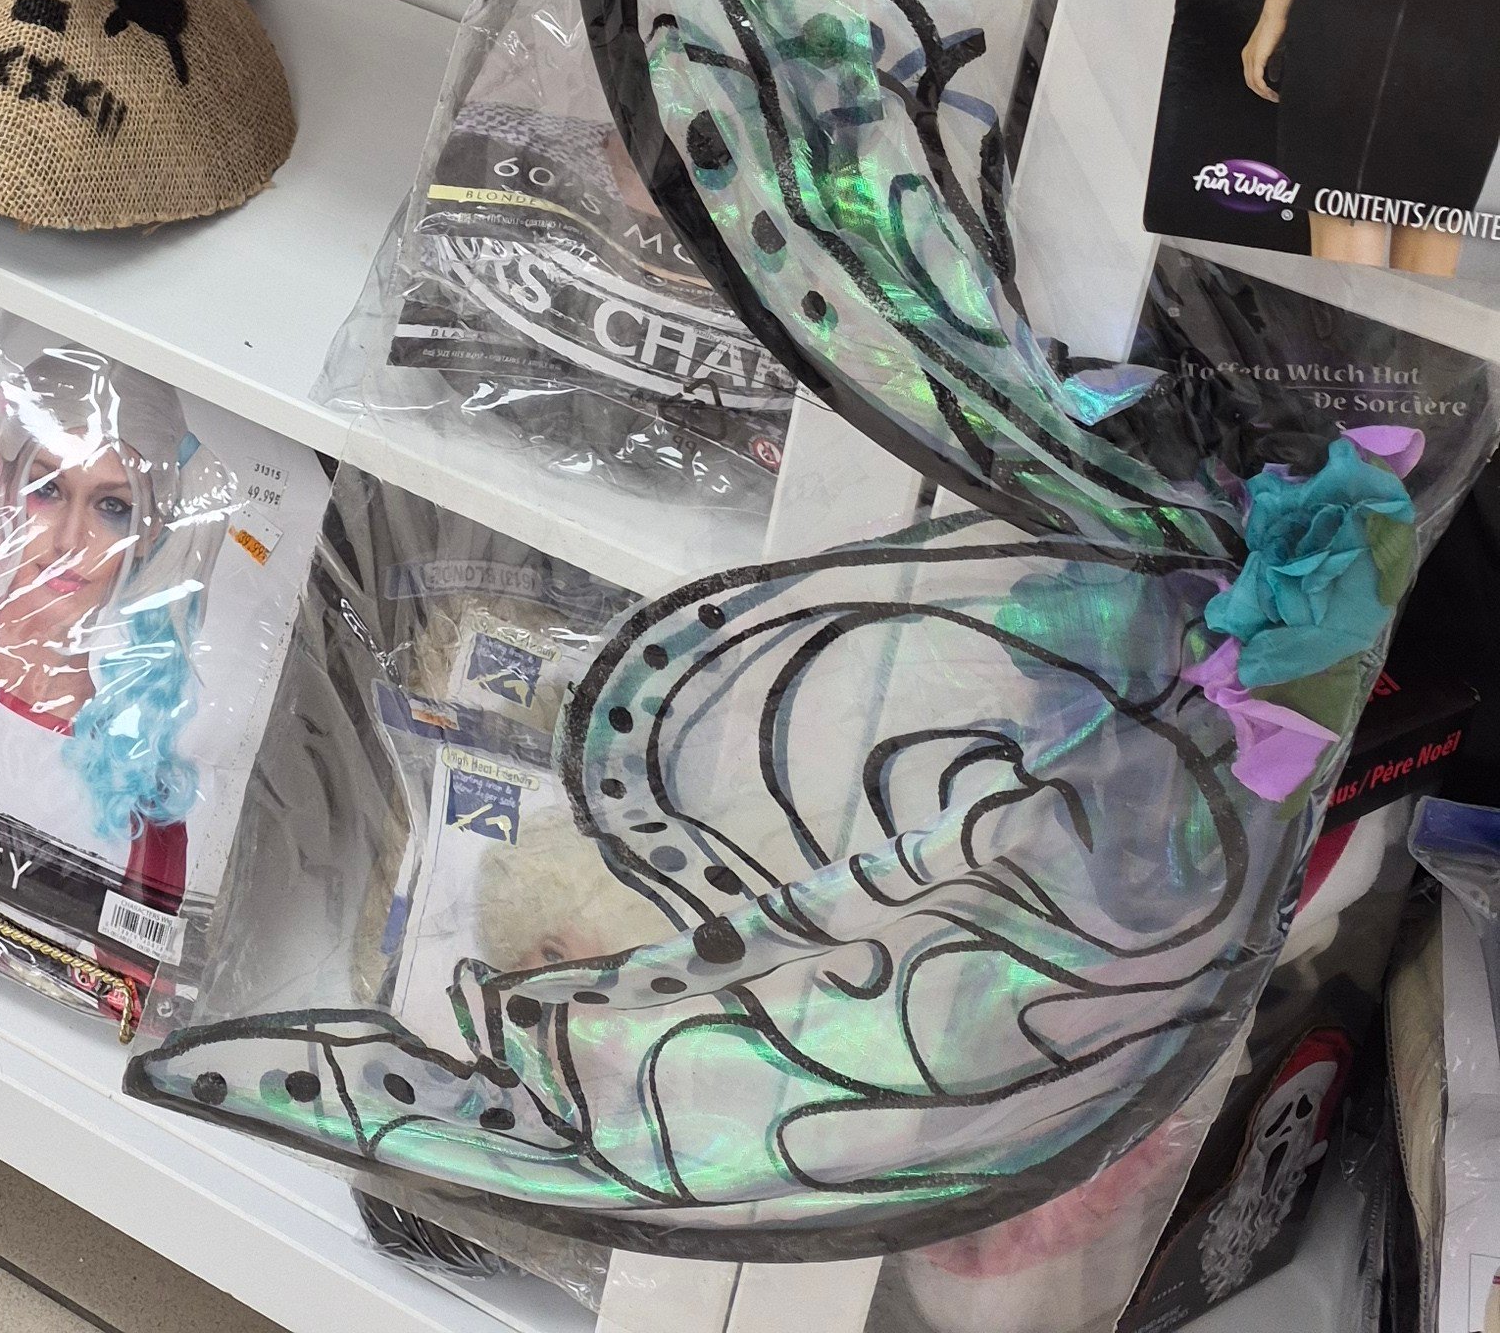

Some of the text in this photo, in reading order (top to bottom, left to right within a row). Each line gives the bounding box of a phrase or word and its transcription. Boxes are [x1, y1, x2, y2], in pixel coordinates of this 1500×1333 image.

[466, 190, 536, 206] BLONDE
[1233, 172, 1300, 205] World
[1287, 364, 1365, 384] Witch
[1373, 366, 1420, 385] Hat
[1312, 389, 1467, 417] De Sorcière
[255, 464, 281, 480] 31315
[1370, 757, 1414, 789] Père
[1416, 729, 1462, 769] Noël
